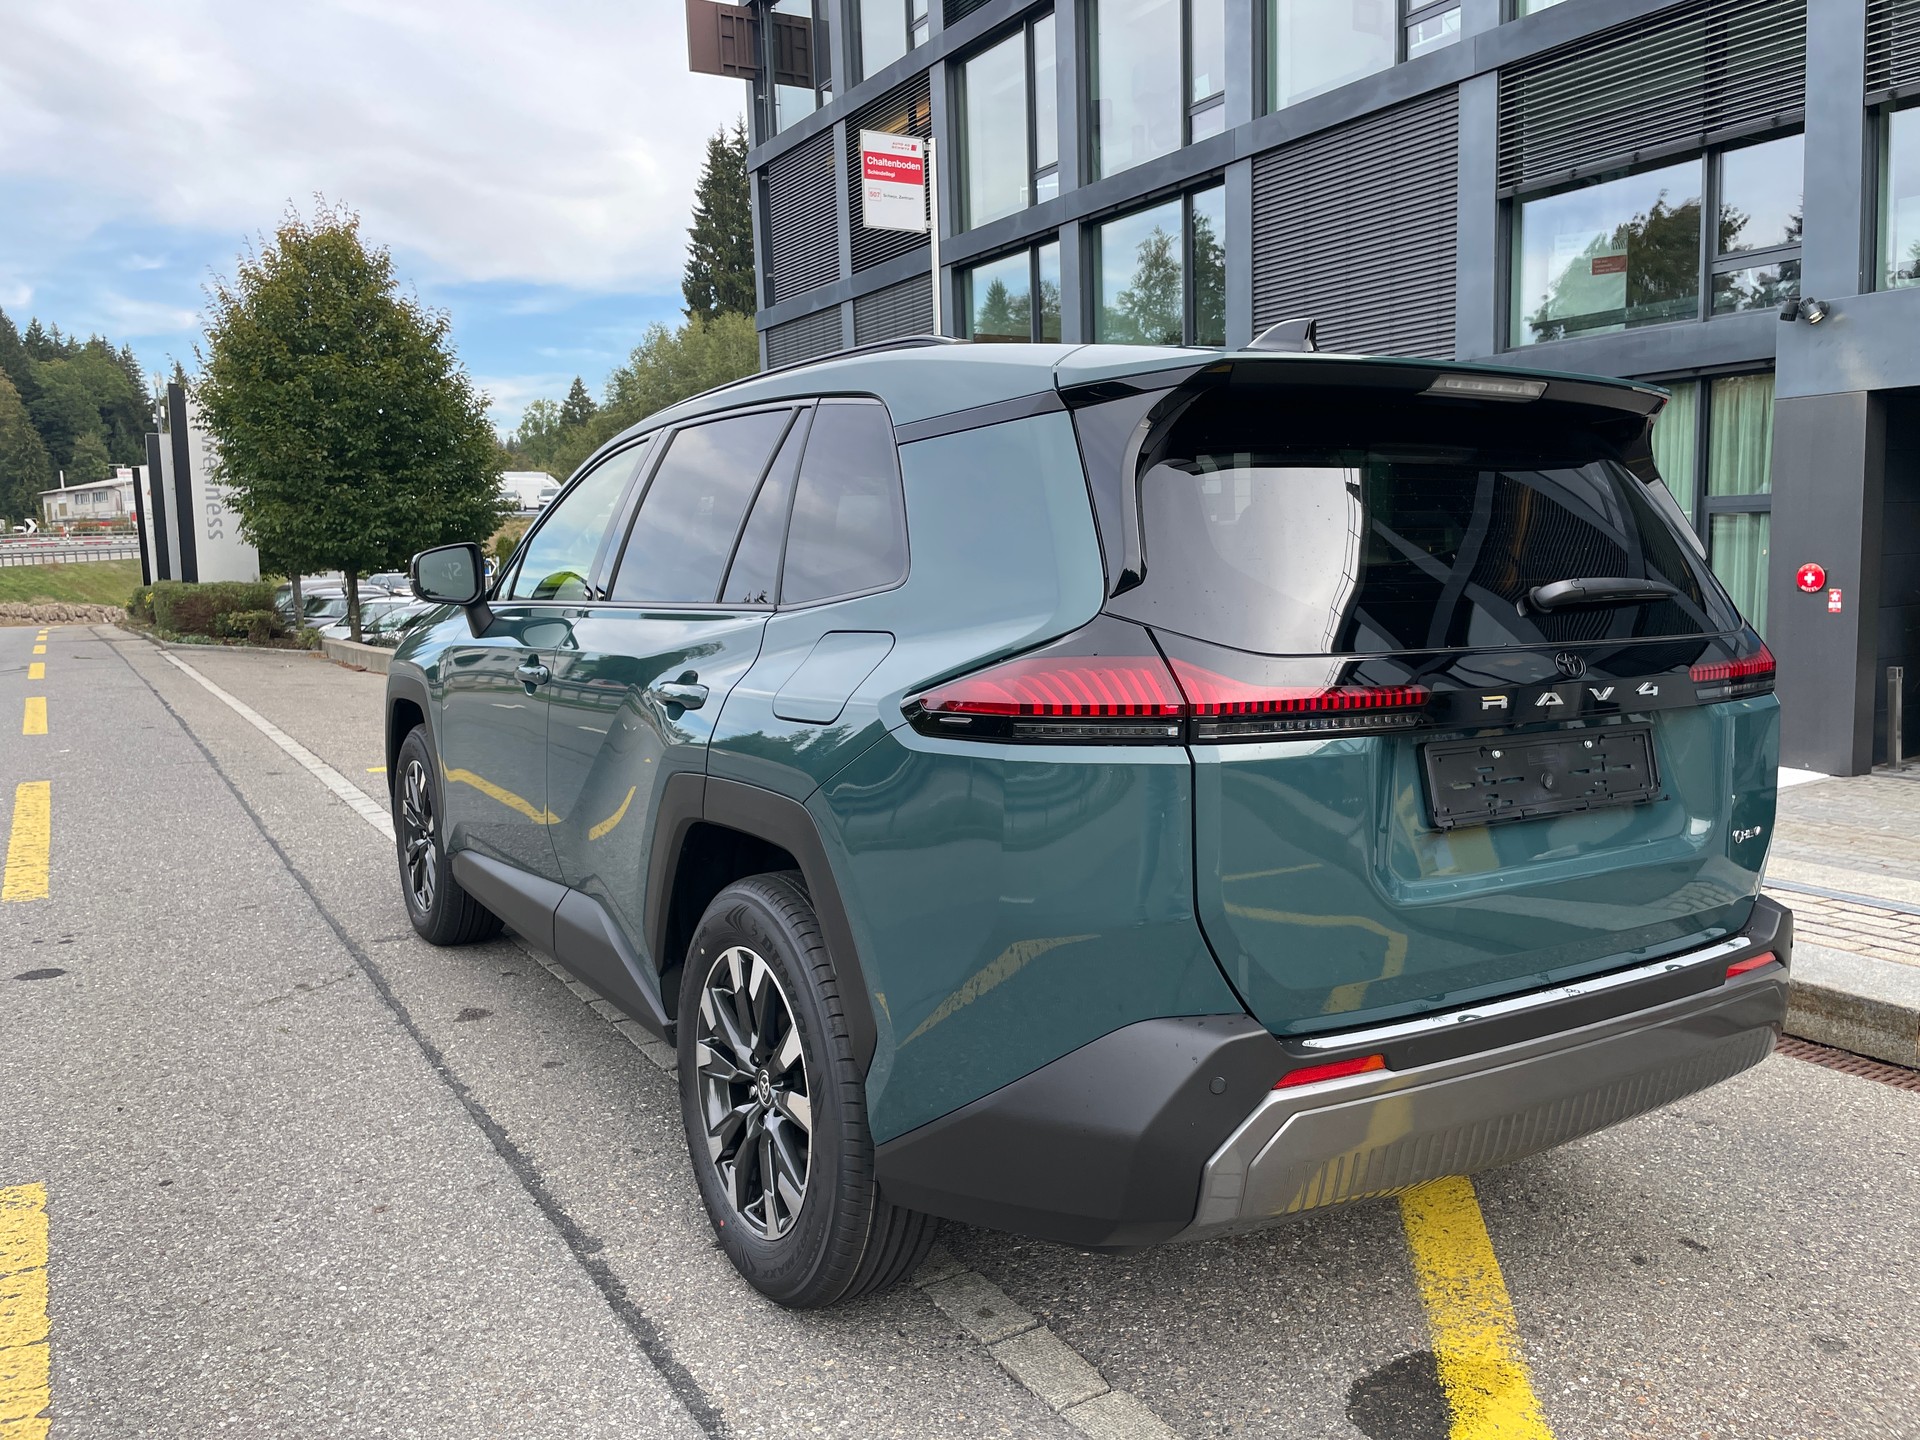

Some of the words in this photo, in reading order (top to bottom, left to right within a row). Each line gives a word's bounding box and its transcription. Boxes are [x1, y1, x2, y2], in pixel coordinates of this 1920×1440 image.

[866, 156, 921, 171] Chaltenboden
[867, 169, 896, 178] Schindellegi
[1482, 681, 1659, 710] RAV4
[760, 934, 814, 1063] DUNLOP
